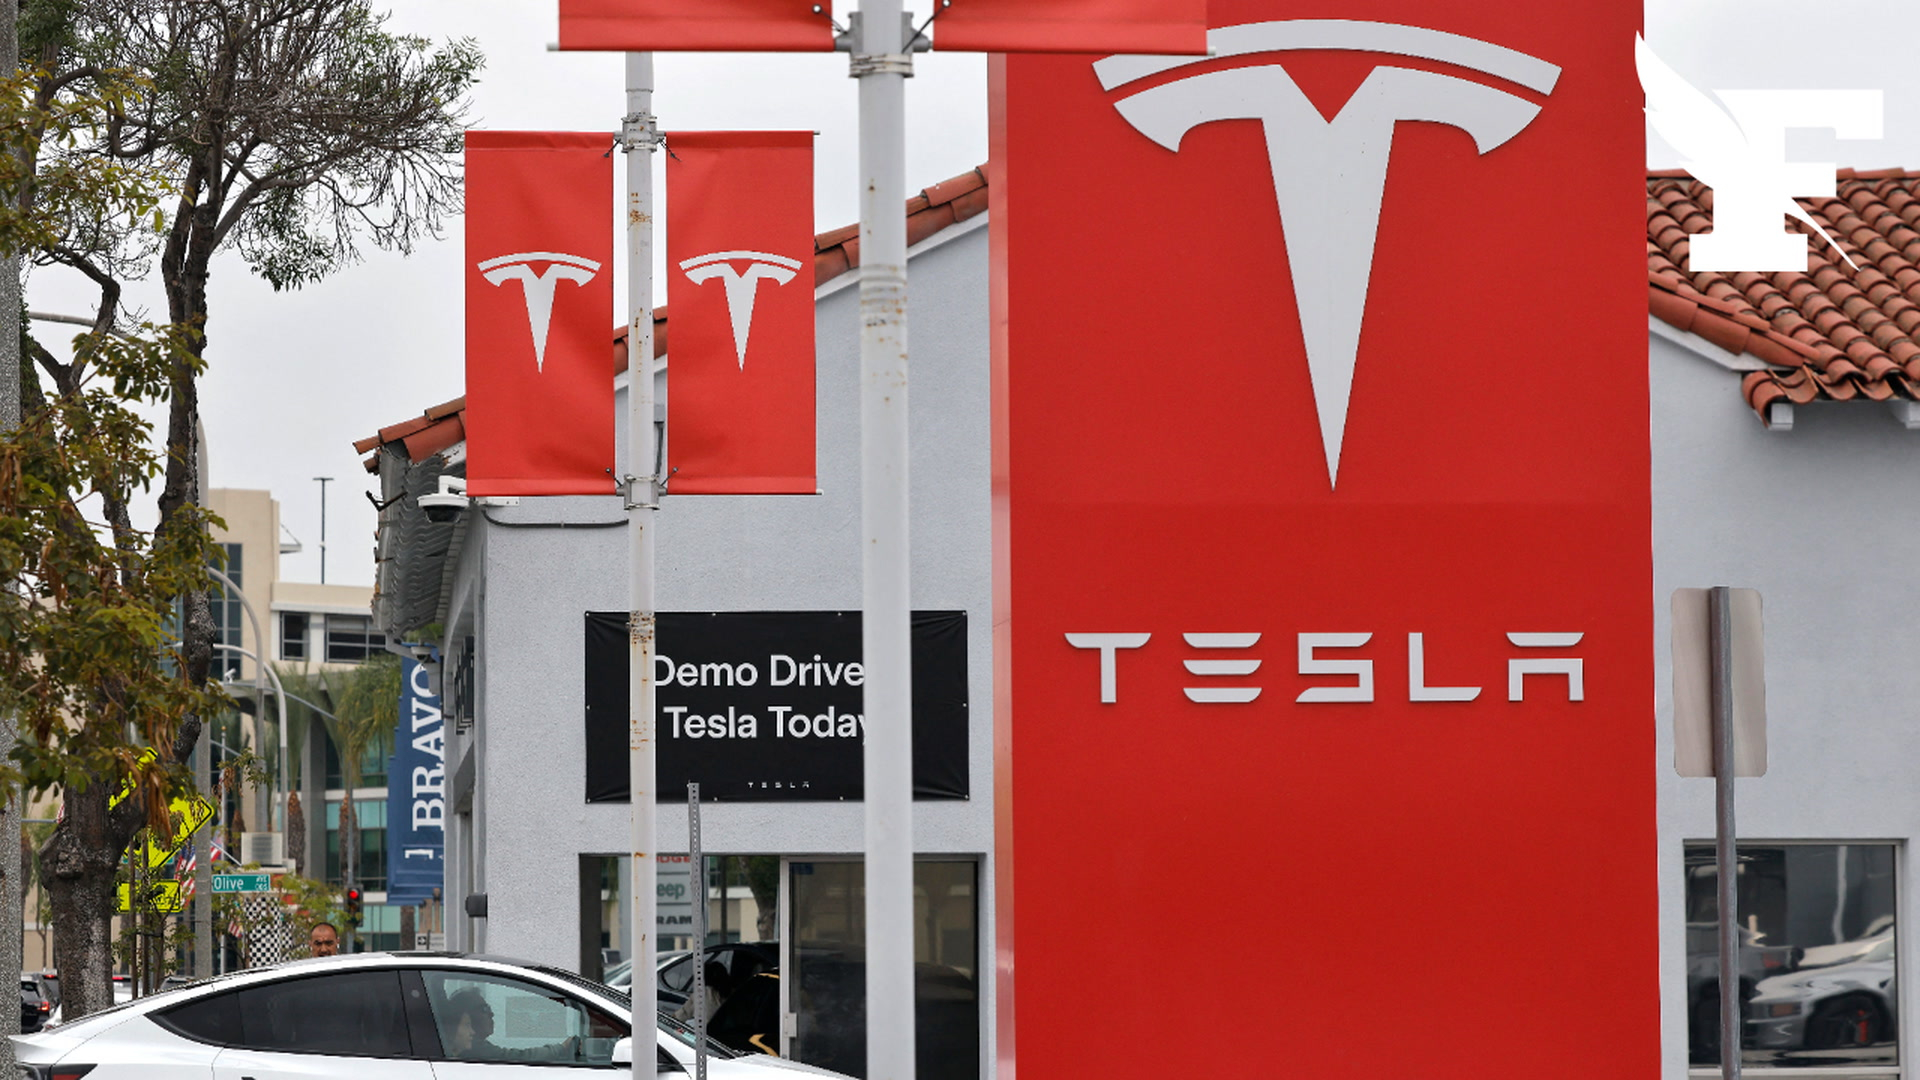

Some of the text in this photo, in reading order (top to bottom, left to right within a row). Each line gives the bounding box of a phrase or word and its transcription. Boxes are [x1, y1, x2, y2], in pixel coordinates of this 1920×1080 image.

[655, 653, 865, 687] Demo Drive
[1064, 632, 1585, 704] TESLA
[663, 705, 758, 739] Tesla
[747, 781, 810, 789] TESLA
[213, 876, 244, 890] Olive
[656, 883, 685, 900] eep
[656, 915, 692, 925] RAM
